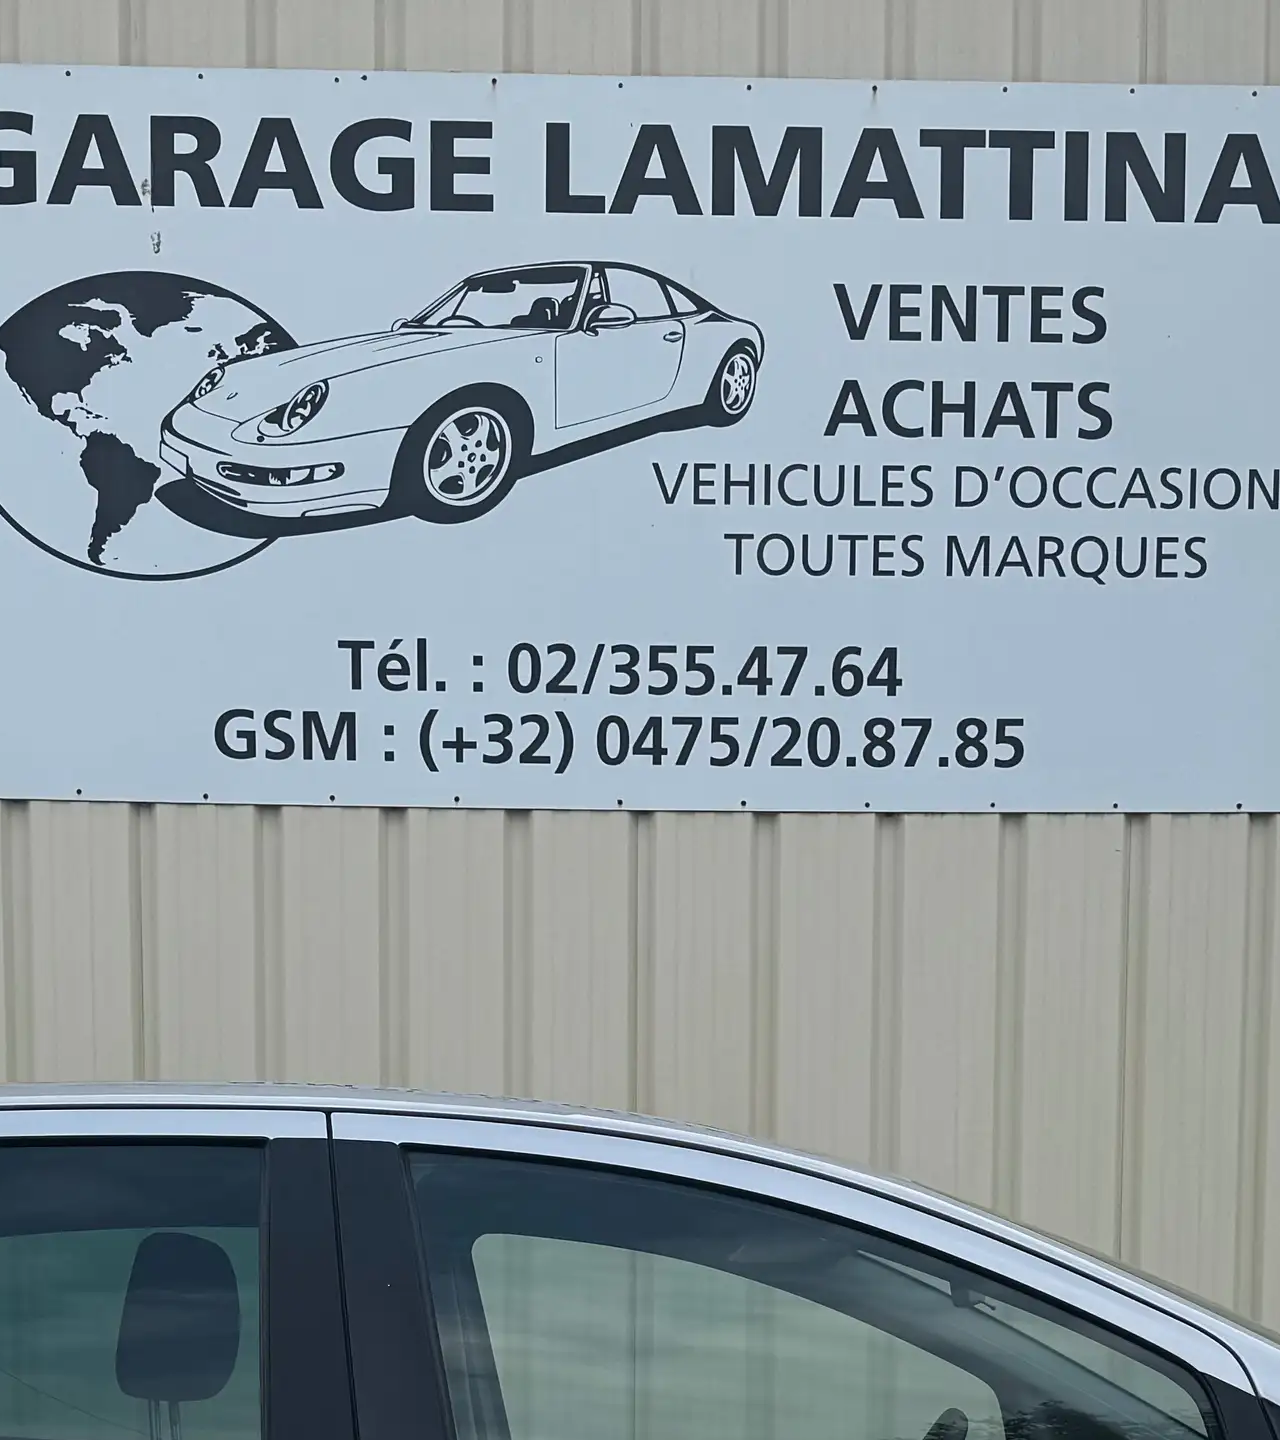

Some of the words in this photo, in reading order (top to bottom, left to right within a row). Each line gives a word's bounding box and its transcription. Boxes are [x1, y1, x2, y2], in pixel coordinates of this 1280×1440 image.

[833, 284, 1106, 344] VENTES
[824, 380, 1112, 439] ACHATS
[652, 463, 933, 507] VEHICULES
[724, 534, 924, 577] TOUTES
[947, 536, 1207, 585] MARQUES
[338, 638, 445, 691] Tél.
[508, 643, 902, 696] 02/355.47.64
[215, 709, 356, 760] GSM
[420, 709, 573, 774] (+32)
[597, 715, 1024, 768] 0475/20.87.85
